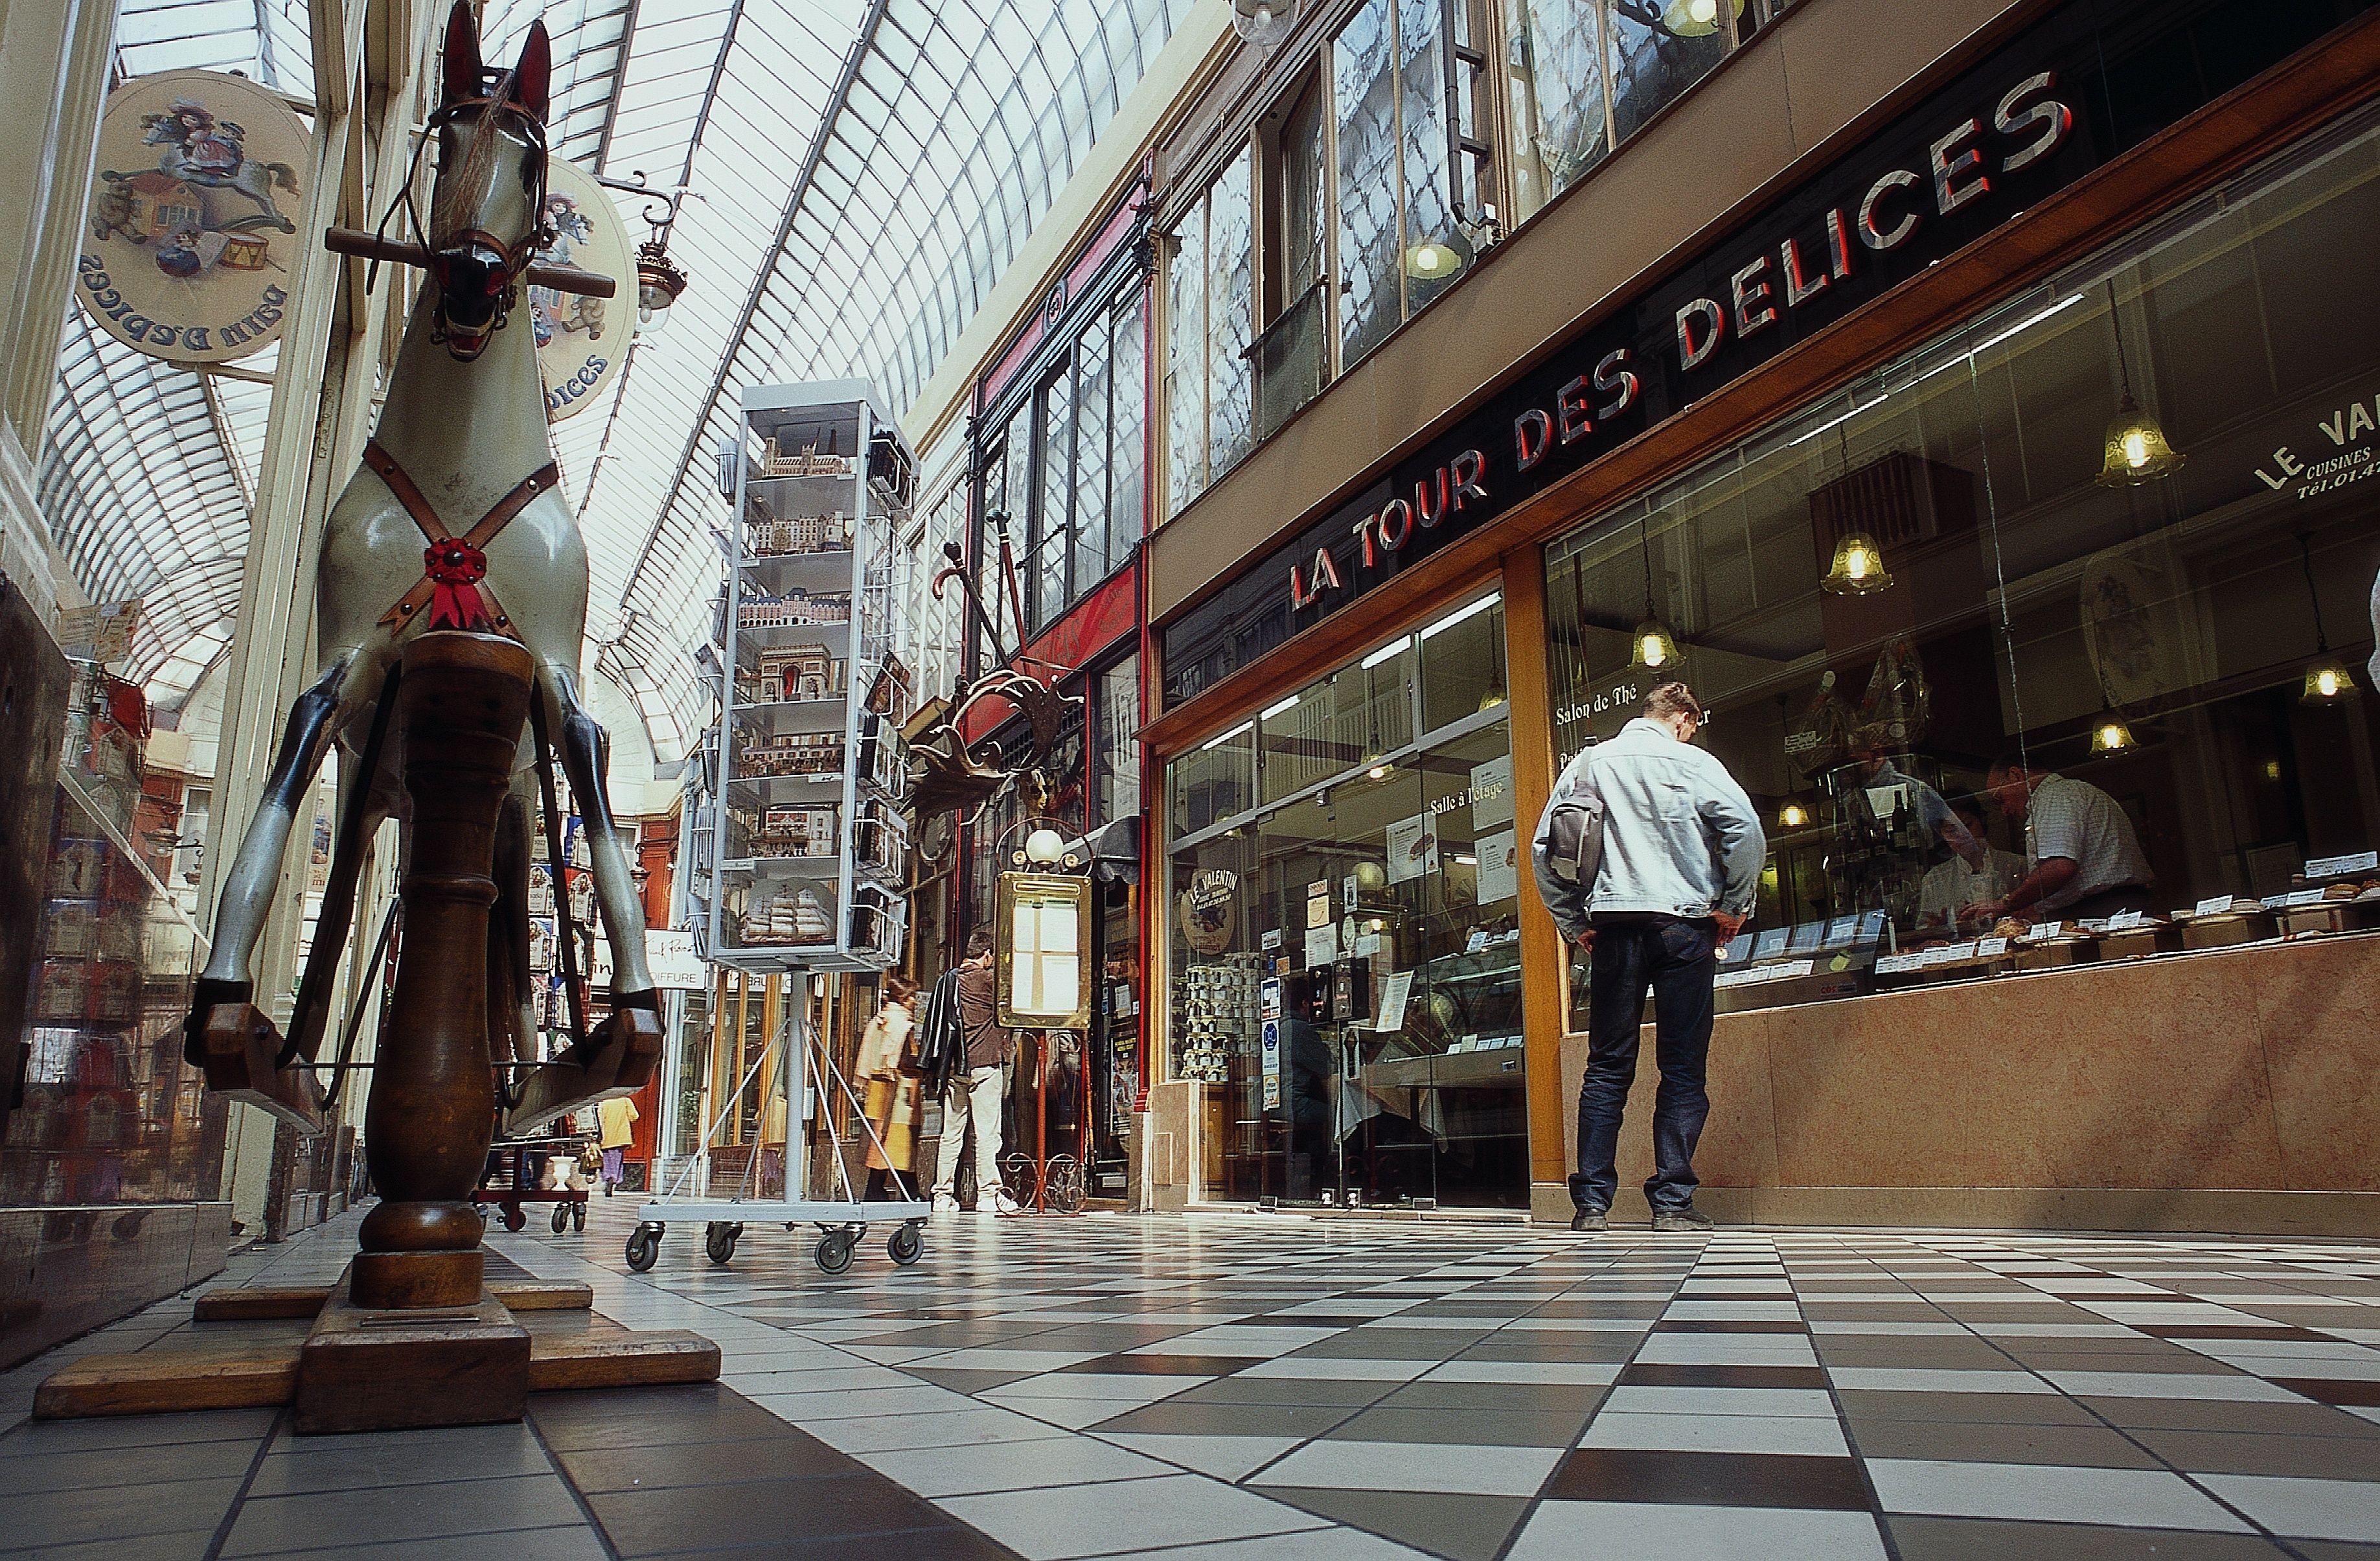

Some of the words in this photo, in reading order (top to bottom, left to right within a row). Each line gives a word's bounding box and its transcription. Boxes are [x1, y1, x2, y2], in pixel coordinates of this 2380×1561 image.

[1290, 548, 1340, 612] LA
[1353, 450, 1487, 568] TOUR
[1515, 349, 1639, 472] DES
[1675, 71, 2072, 371] DELICES
[2254, 446, 2305, 490] LE
[2306, 446, 2371, 480] CUISINES
[1556, 703, 1590, 726] Salon
[1594, 694, 1608, 713] de
[1612, 683, 1637, 706] Thé
[1430, 795, 1456, 816] Salle
[1458, 791, 1465, 808] à
[1190, 885, 1200, 905] LE
[1202, 870, 1238, 890] VALENTIN
[650, 972, 696, 983] OIFFURE
